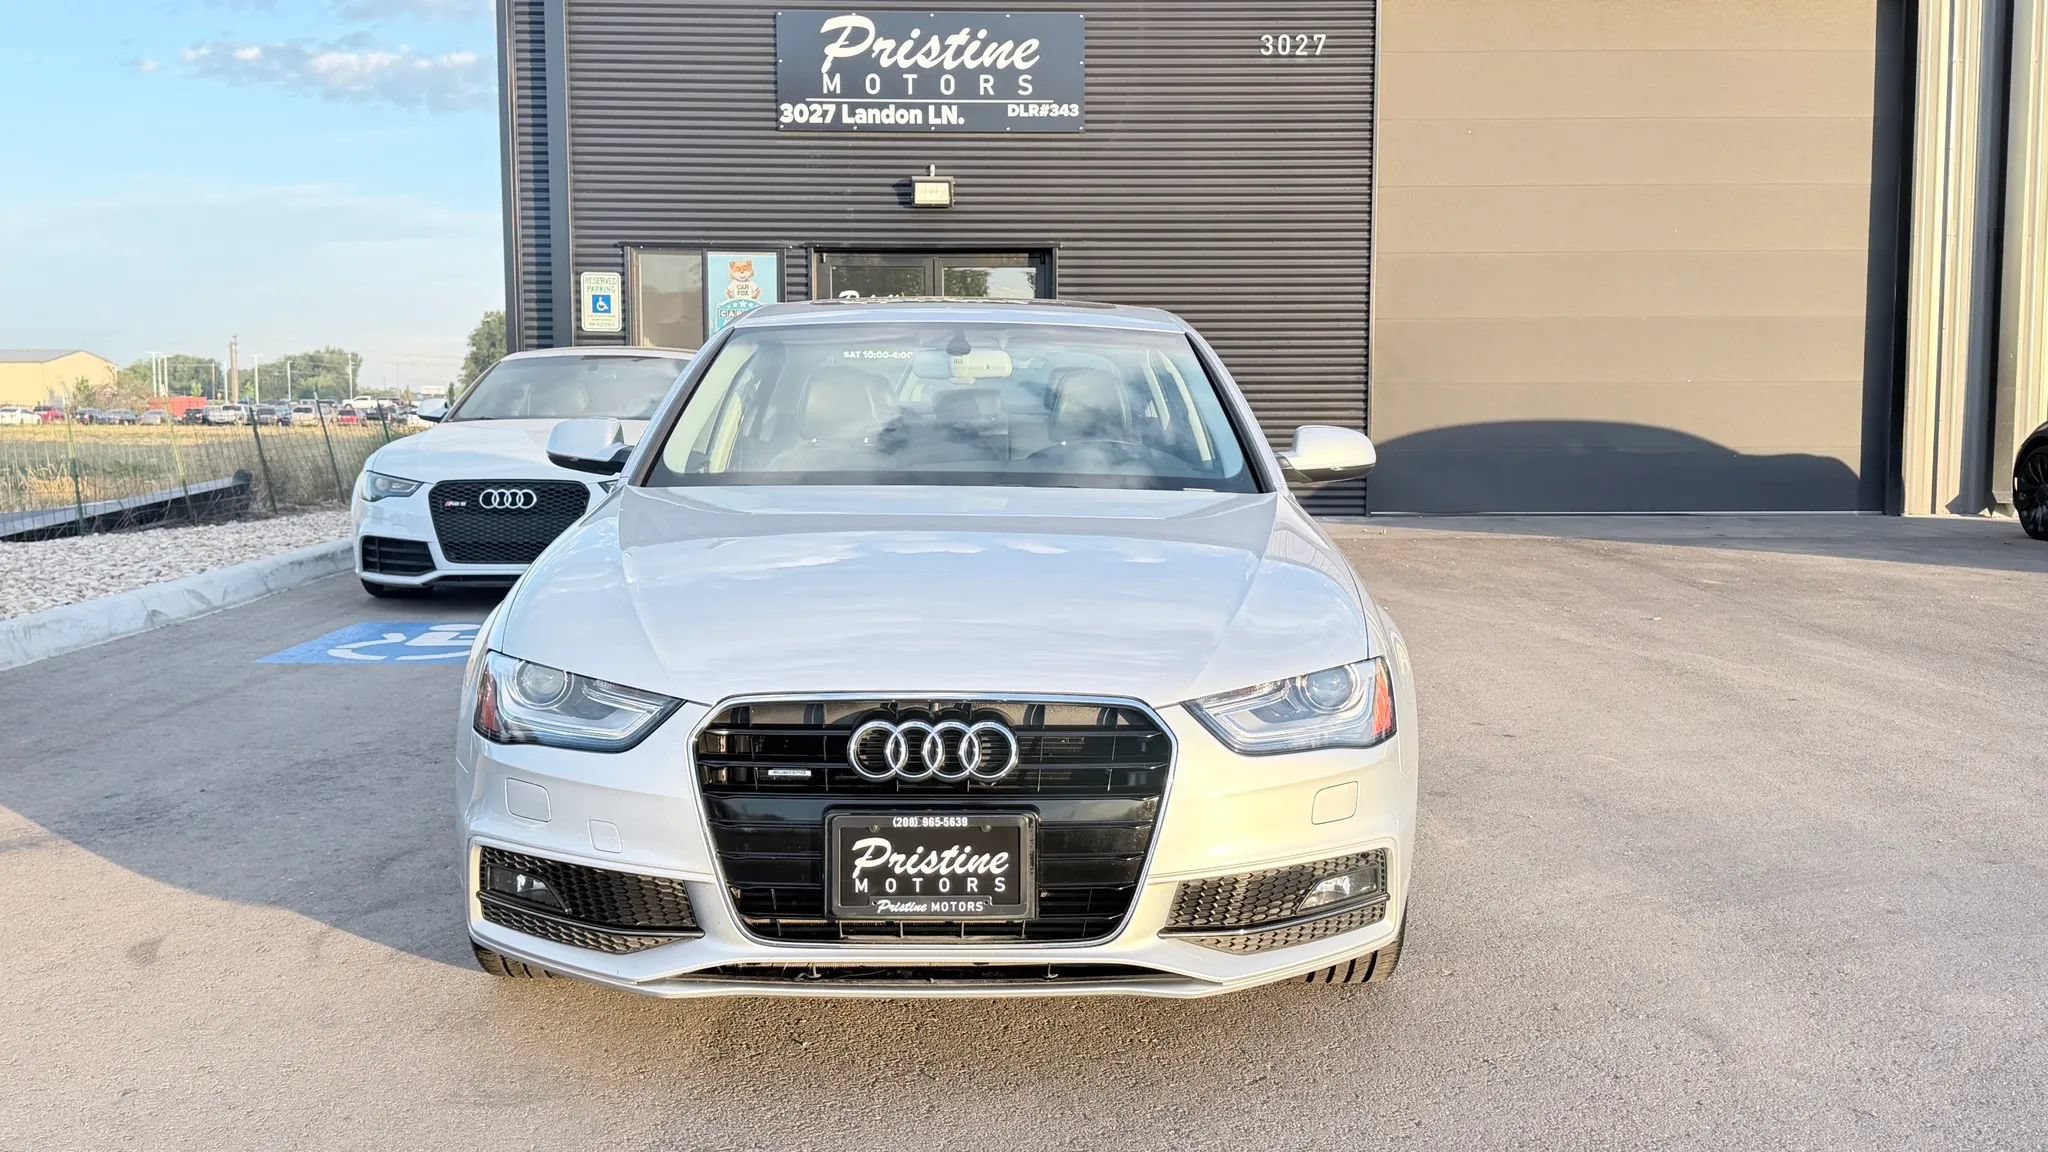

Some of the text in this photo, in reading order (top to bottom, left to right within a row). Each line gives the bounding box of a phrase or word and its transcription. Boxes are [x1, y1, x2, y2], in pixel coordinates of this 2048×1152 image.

[820, 14, 1040, 73] Pristine
[1260, 34, 1327, 56] 3027
[822, 73, 1033, 96] MOTORS
[779, 103, 965, 125] 3027 Landon LN.
[1007, 103, 1080, 117] DLR#343
[585, 276, 617, 285] RESERVED
[586, 285, 616, 294] PARKING
[843, 351, 861, 359] SAT
[892, 816, 968, 828] (208) 965-5639
[852, 837, 1009, 879] Pristine
[855, 878, 1006, 893] MOTORS
[877, 900, 984, 913] Pristine MOTORS
